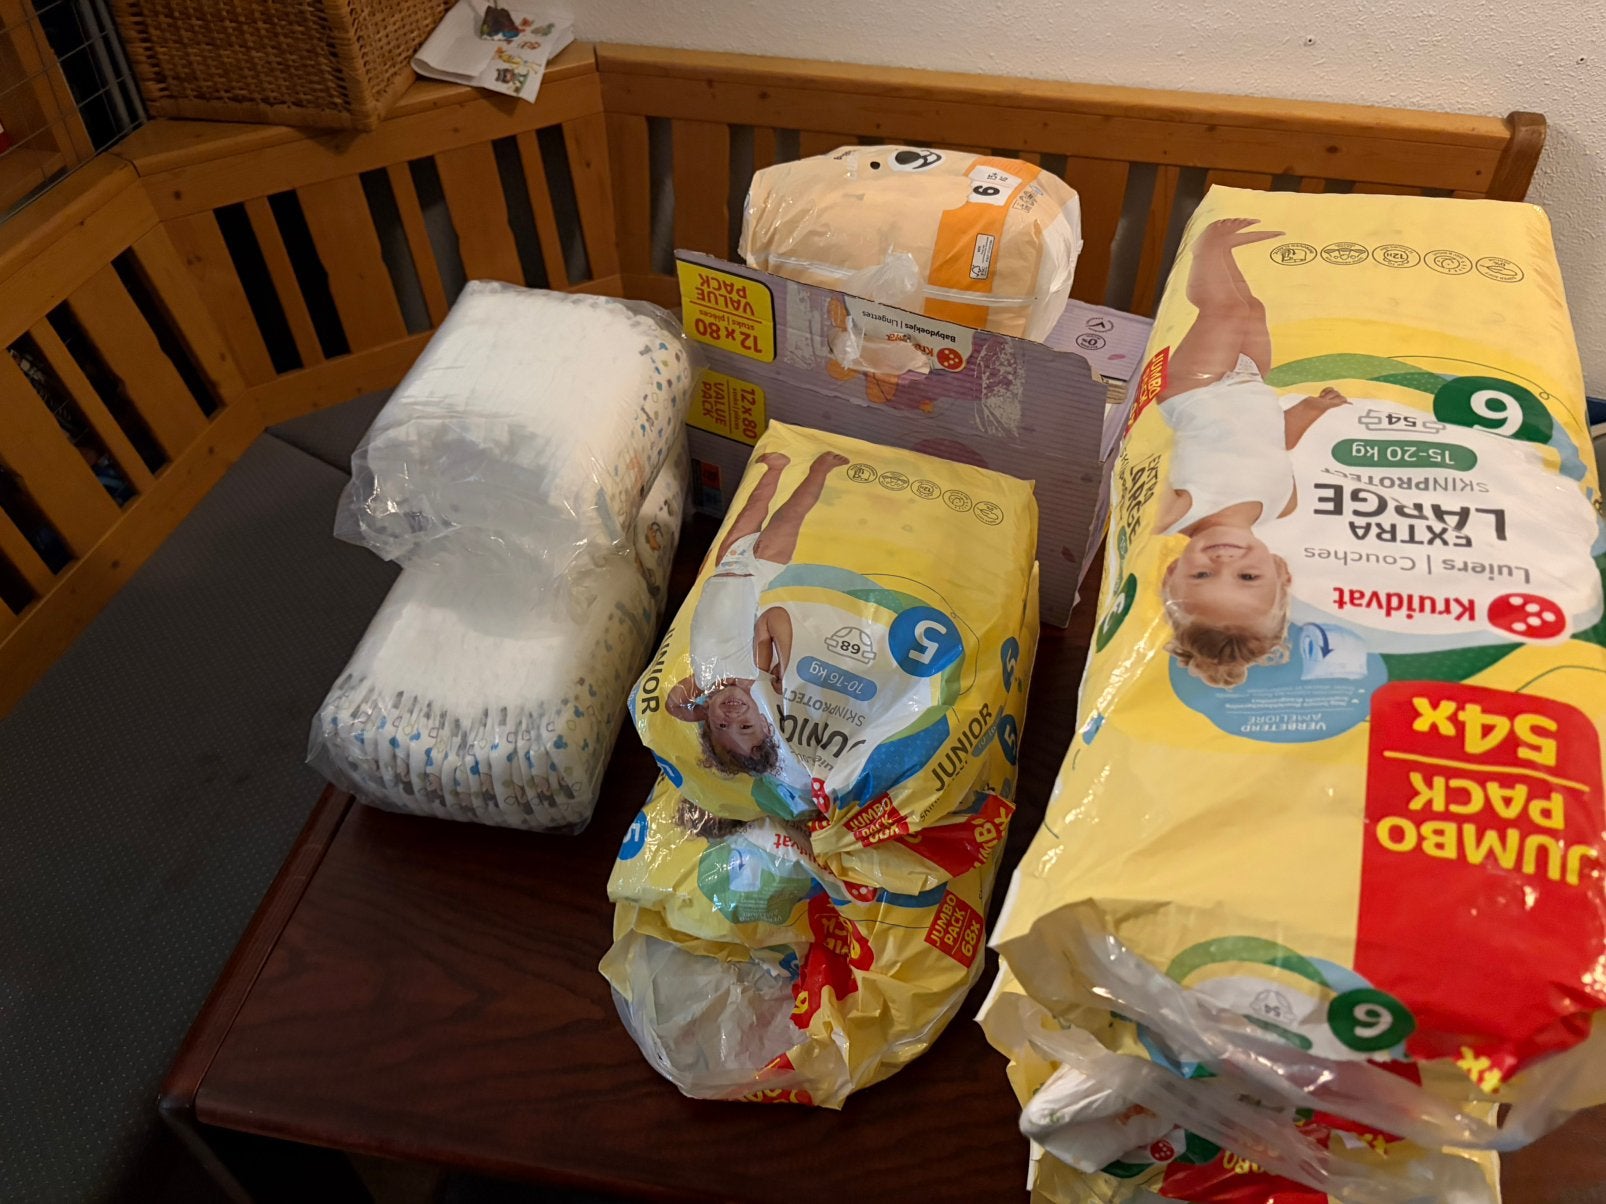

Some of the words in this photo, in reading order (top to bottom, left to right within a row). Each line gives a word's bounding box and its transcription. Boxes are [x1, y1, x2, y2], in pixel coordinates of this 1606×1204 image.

[972, 185, 1001, 197] 6
[695, 286, 756, 317] VALUE
[698, 273, 748, 300] PACK
[694, 318, 722, 341] 80
[862, 310, 899, 328] Lingettes
[904, 323, 957, 343] Babydoekjes
[739, 331, 763, 354] 12
[702, 381, 715, 418] PACK
[713, 382, 728, 428] VALUE
[740, 388, 757, 407] 12
[742, 417, 758, 440] 80
[1385, 413, 1418, 428] 54
[1469, 389, 1525, 438] 6
[1352, 442, 1380, 461] kg
[1387, 447, 1455, 465] 15-20
[1147, 453, 1162, 505] EXTRA
[1313, 482, 1508, 542] LARGE
[1348, 520, 1474, 549] EXTRA
[1303, 547, 1417, 572] Couches
[1441, 557, 1532, 584] Luiers
[1333, 586, 1477, 622] Kruidvat
[839, 640, 862, 655] 68
[908, 620, 948, 665] 5
[809, 661, 827, 683] kg
[828, 671, 865, 696] 10-16
[1411, 696, 1559, 768] 54x
[929, 702, 993, 793] JUNIOR
[849, 796, 893, 831] JUMBO
[1407, 771, 1566, 831] PACK
[1376, 815, 1598, 887] JUMBO
[929, 893, 957, 946] JUMBO
[944, 908, 966, 946] PACK
[961, 920, 981, 957] 68x
[1353, 1003, 1394, 1039] 6
